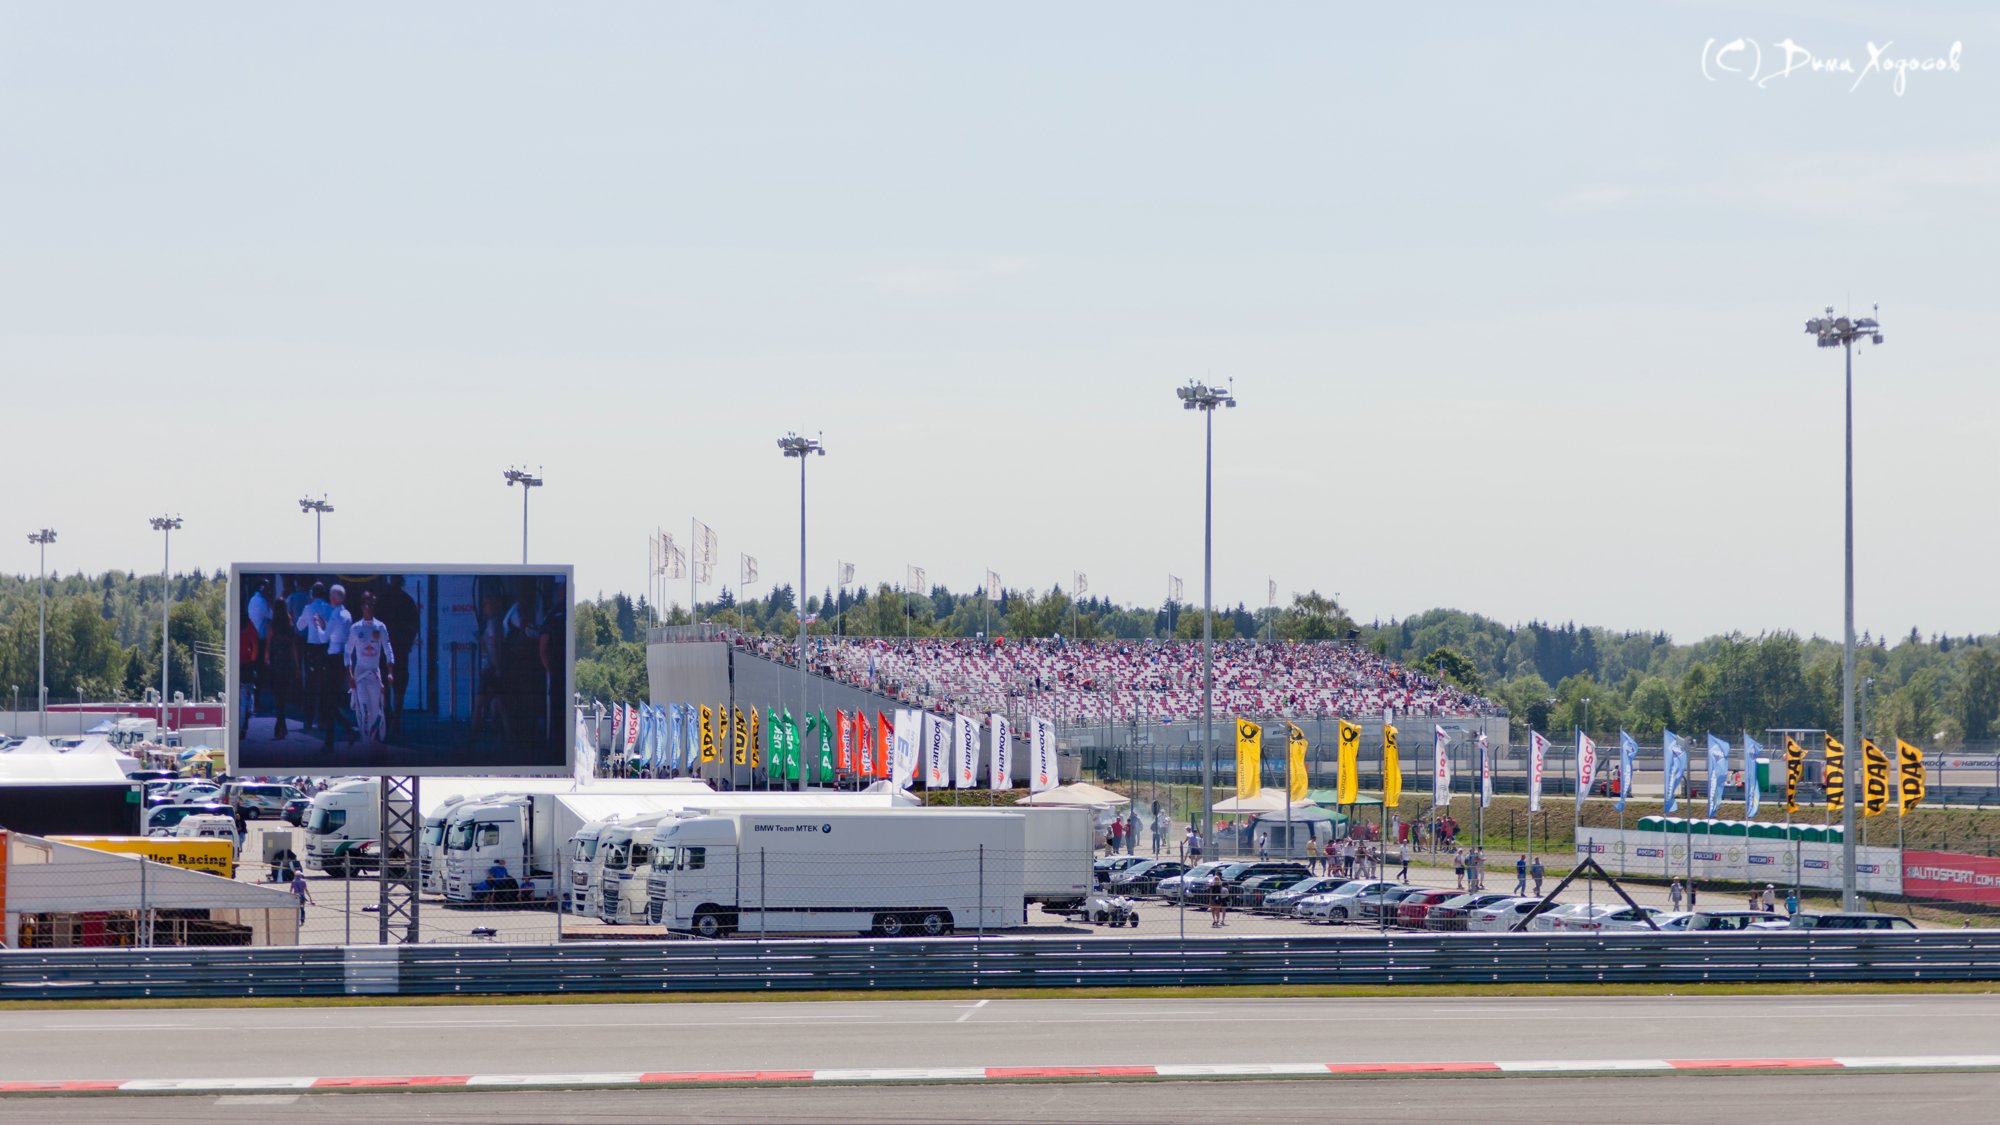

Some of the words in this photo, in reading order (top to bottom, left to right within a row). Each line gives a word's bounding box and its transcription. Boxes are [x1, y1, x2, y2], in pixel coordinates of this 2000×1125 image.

[1865, 745, 1887, 812] ADAC
[754, 824, 774, 832] BMW
[775, 824, 795, 832] Team
[796, 824, 818, 832] MTEK
[148, 853, 173, 864] ller
[178, 854, 227, 868] Racing
